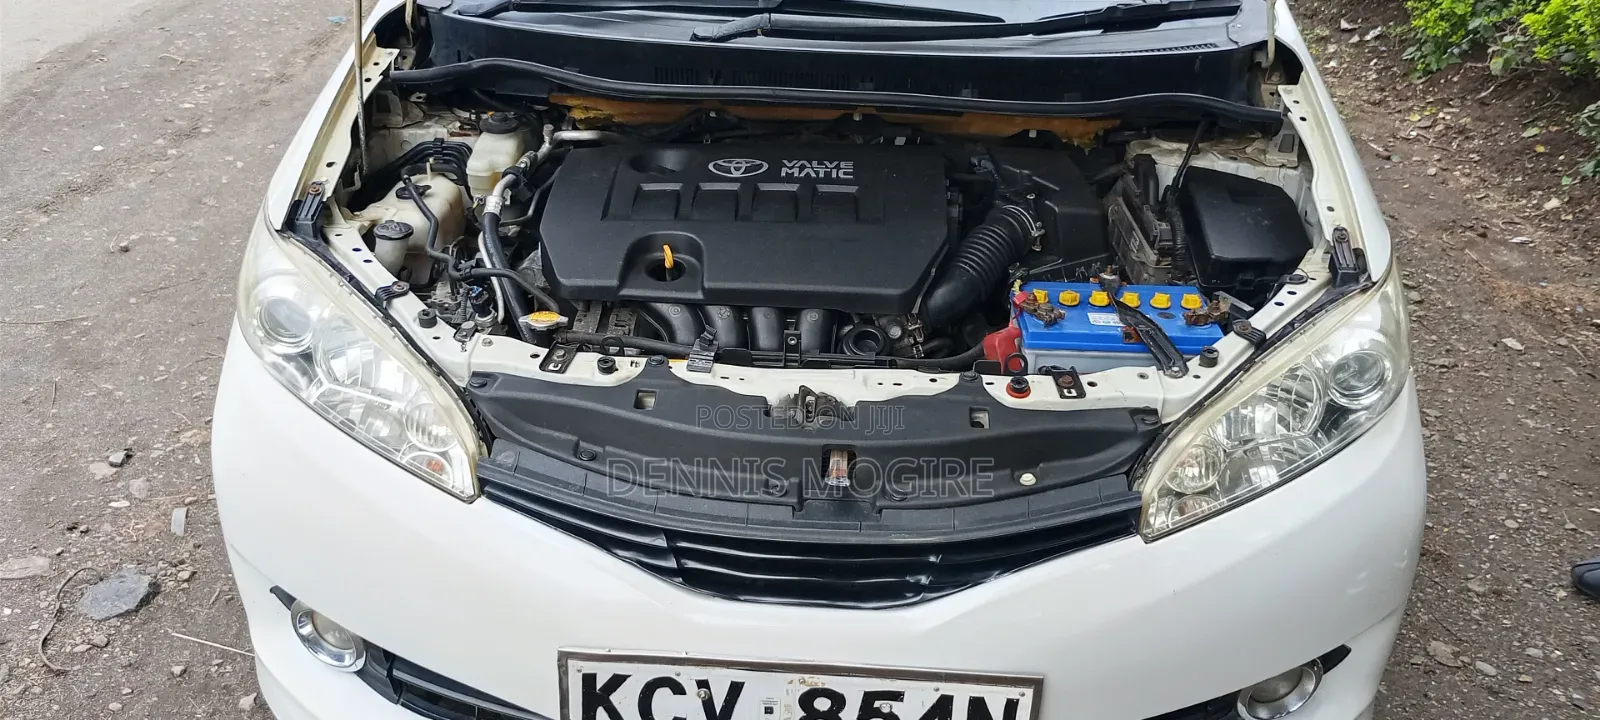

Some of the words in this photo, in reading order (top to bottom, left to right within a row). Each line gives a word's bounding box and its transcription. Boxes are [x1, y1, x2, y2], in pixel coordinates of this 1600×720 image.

[782, 159, 854, 168] VALVE
[780, 168, 854, 179] MATIC
[581, 672, 746, 720] KCV
